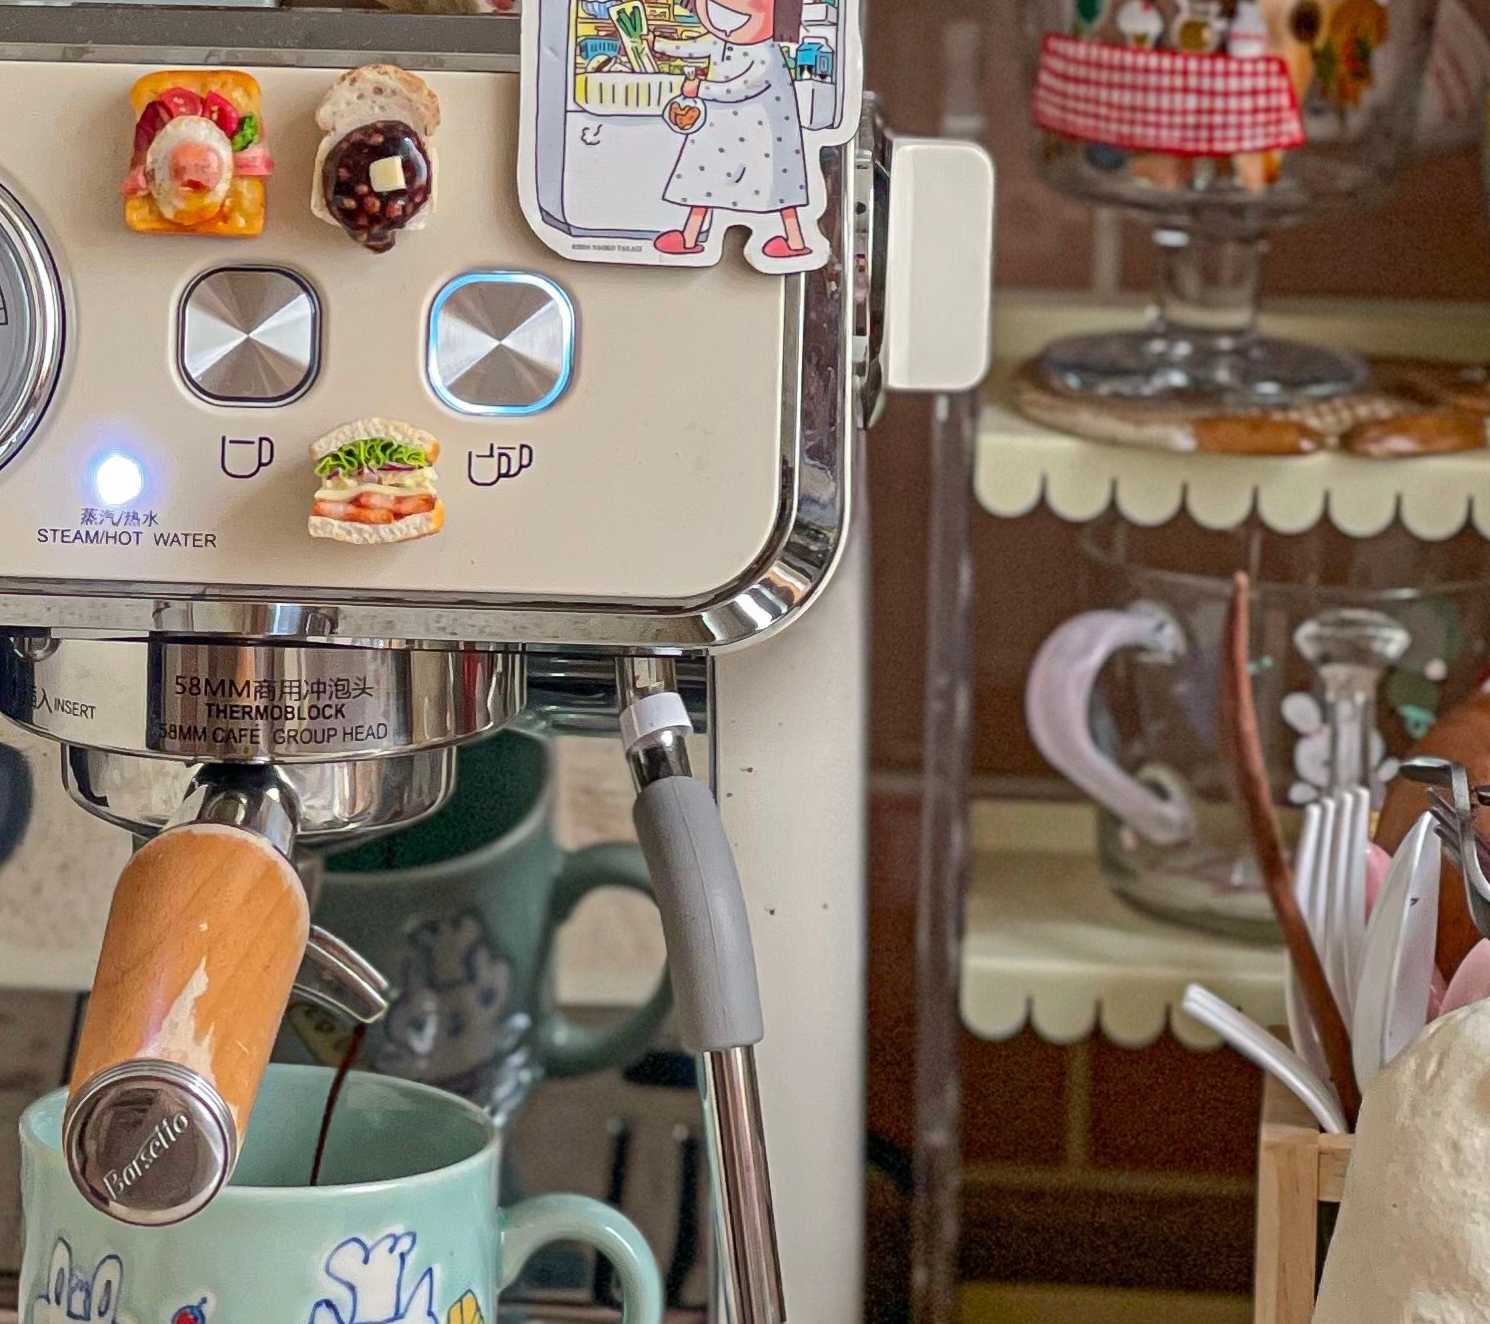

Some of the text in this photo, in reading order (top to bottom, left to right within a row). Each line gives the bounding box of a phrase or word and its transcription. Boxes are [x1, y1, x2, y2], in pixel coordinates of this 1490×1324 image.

[80, 507, 159, 527] 蒸汽/热水
[37, 528, 217, 548] STEAM/HOT WATER
[174, 675, 375, 702] 58MM商用冲泡头
[54, 697, 97, 720] INSERT
[204, 702, 346, 721] THERMOBLOCK
[159, 723, 208, 743] 58MM
[273, 727, 337, 745] GROUP
[342, 722, 388, 743] HEAD
[101, 1112, 190, 1201] Barsetto
